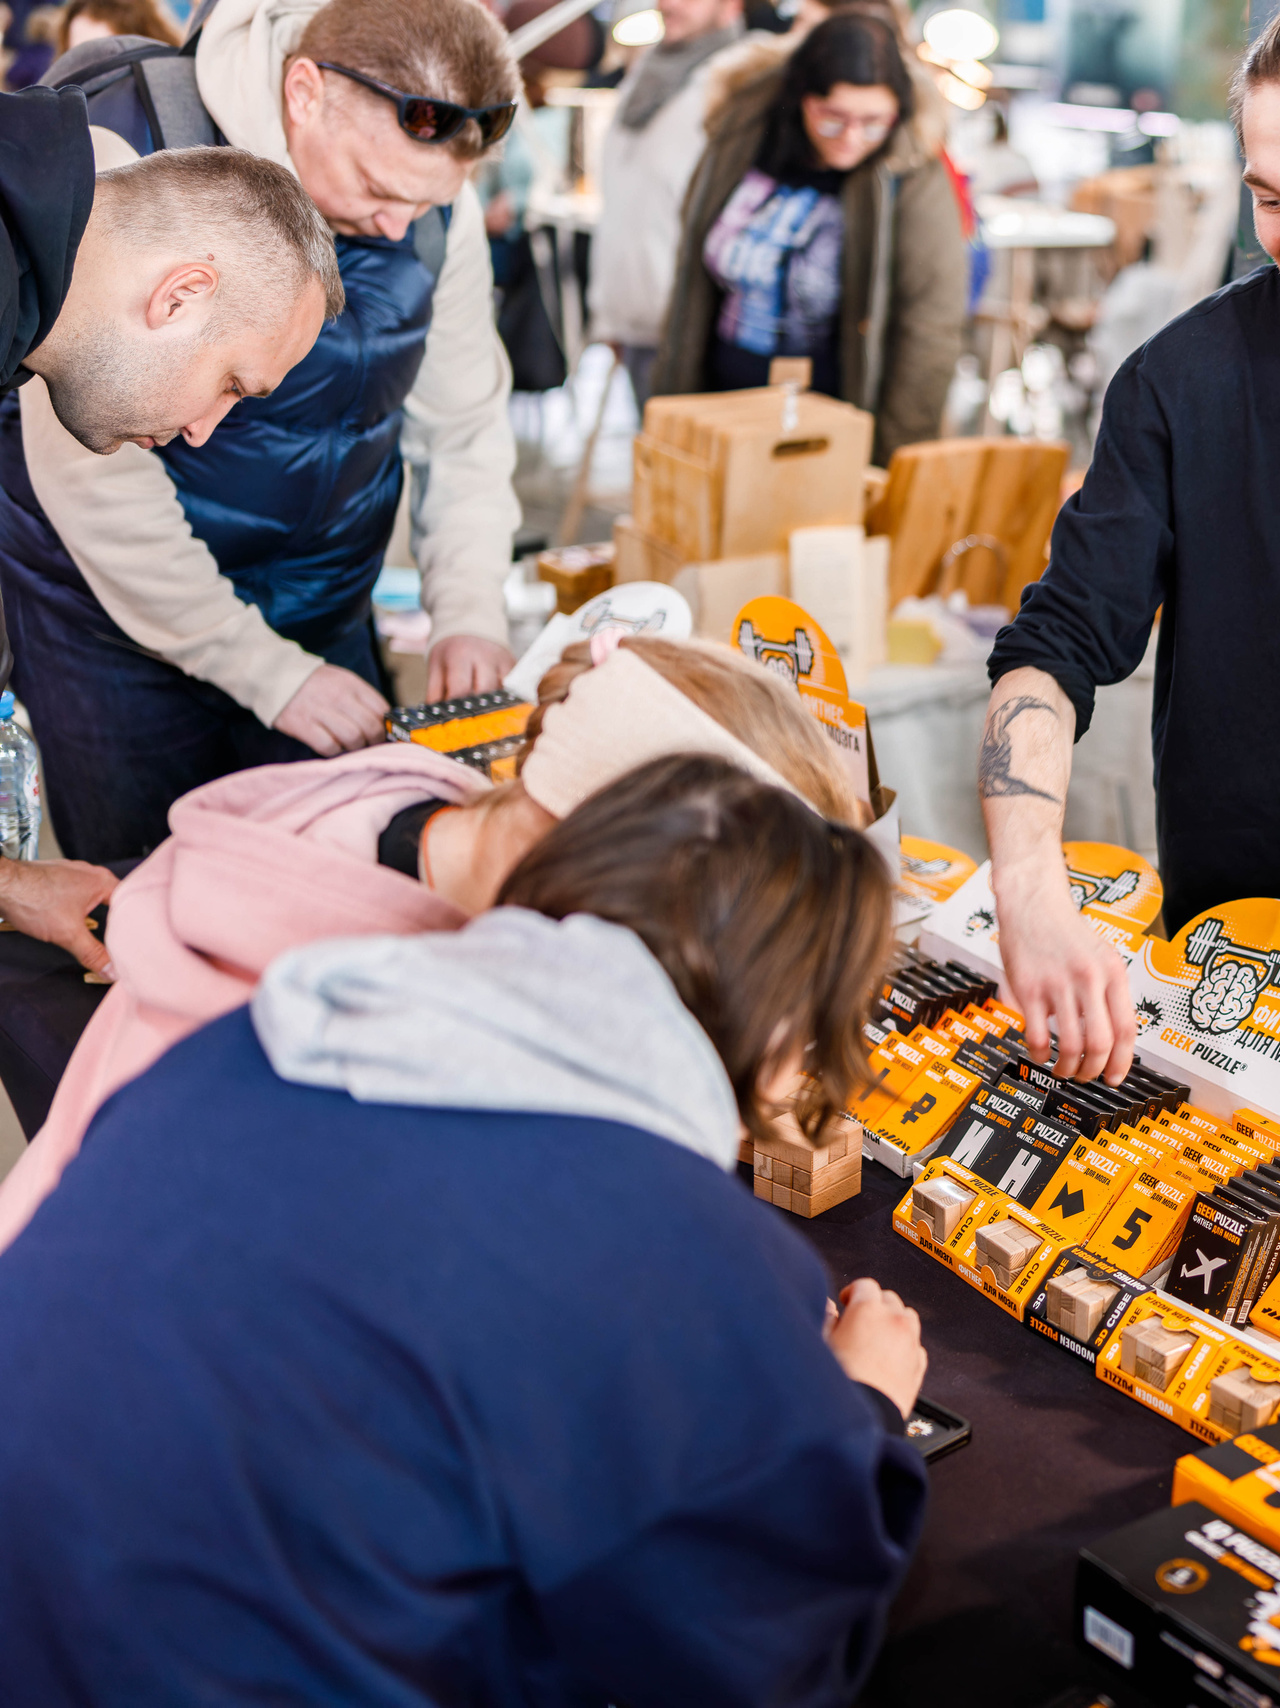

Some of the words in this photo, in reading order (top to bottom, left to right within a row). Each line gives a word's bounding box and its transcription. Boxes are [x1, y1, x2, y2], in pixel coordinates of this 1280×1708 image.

[1083, 914, 1133, 949] ИТНЕС
[890, 988, 917, 1014] PUZZLE
[863, 1023, 889, 1045] PUZZL
[950, 1020, 980, 1042] PUZZLE
[972, 1015, 1001, 1037] PUZZLE
[1160, 1027, 1195, 1052] GEEK
[1234, 1025, 1275, 1055] ДЛЯ
[893, 1042, 925, 1065] PUZZLE
[919, 1036, 951, 1057] PUZZLE
[931, 1061, 972, 1089] GEEKPUZZLE
[1020, 1063, 1029, 1081] IQ
[1030, 1069, 1061, 1090] PUZZLE
[975, 1089, 989, 1105] IQ
[985, 1094, 1021, 1119] PUZZLE
[998, 1082, 1043, 1111] GEEKPUZZLE
[1021, 1116, 1035, 1133] IQ
[1032, 1122, 1069, 1148] PUZZLE
[1190, 1116, 1218, 1133] PUZZL
[1236, 1122, 1280, 1151] GEEKPUZZLE
[923, 1167, 935, 1181] 3D
[1073, 1144, 1087, 1161] IQ
[1083, 1150, 1121, 1177] PUZZLE
[1183, 1146, 1230, 1177] GEEKPUZZLE
[940, 1160, 974, 1180] WOODEN
[970, 1178, 999, 1197] PUZZLE
[1138, 1172, 1186, 1204] GEEKPUZZLE
[973, 1200, 985, 1215] 3D
[1133, 1183, 1153, 1197] ФИТНЕС
[1161, 1199, 1179, 1211] МОЗГА
[988, 1209, 1000, 1224] 3D
[1006, 1202, 1041, 1225] WOODEN
[1036, 1223, 1067, 1243] PUZZLE
[1192, 1214, 1212, 1230] ФИТНЕС
[1223, 1230, 1241, 1246] МОЗГА
[1195, 1201, 1246, 1237] GEEKPUZZLE
[895, 1220, 919, 1241] ФИТНЕС
[920, 1237, 933, 1250] ДЛЯ
[934, 1246, 953, 1266] МОЗГА
[950, 1216, 973, 1248] CUBE
[1039, 1245, 1052, 1261] 3D
[1071, 1247, 1096, 1264] МОЗГА
[1095, 1260, 1118, 1274] ДЛЯ
[1265, 1252, 1279, 1280] PUZZLE
[958, 1264, 982, 1287] ФИТНЕС
[983, 1282, 997, 1297] ДЛЯ
[998, 1292, 1018, 1313] МОЗГА
[1015, 1262, 1039, 1294] CUBE
[1112, 1271, 1147, 1291] ФИТНЕС
[1032, 1292, 1046, 1310] 3D
[1030, 1316, 1059, 1341] PUZZLE
[1095, 1329, 1109, 1347] 3D
[1106, 1292, 1132, 1328] CUBE
[1060, 1333, 1095, 1363] WOODEN
[1106, 1343, 1120, 1360] 3D
[1103, 1368, 1133, 1393] PUZZLE
[1174, 1381, 1187, 1398] 3D
[1184, 1343, 1211, 1380] CUBE
[1135, 1386, 1173, 1416] WOODEN
